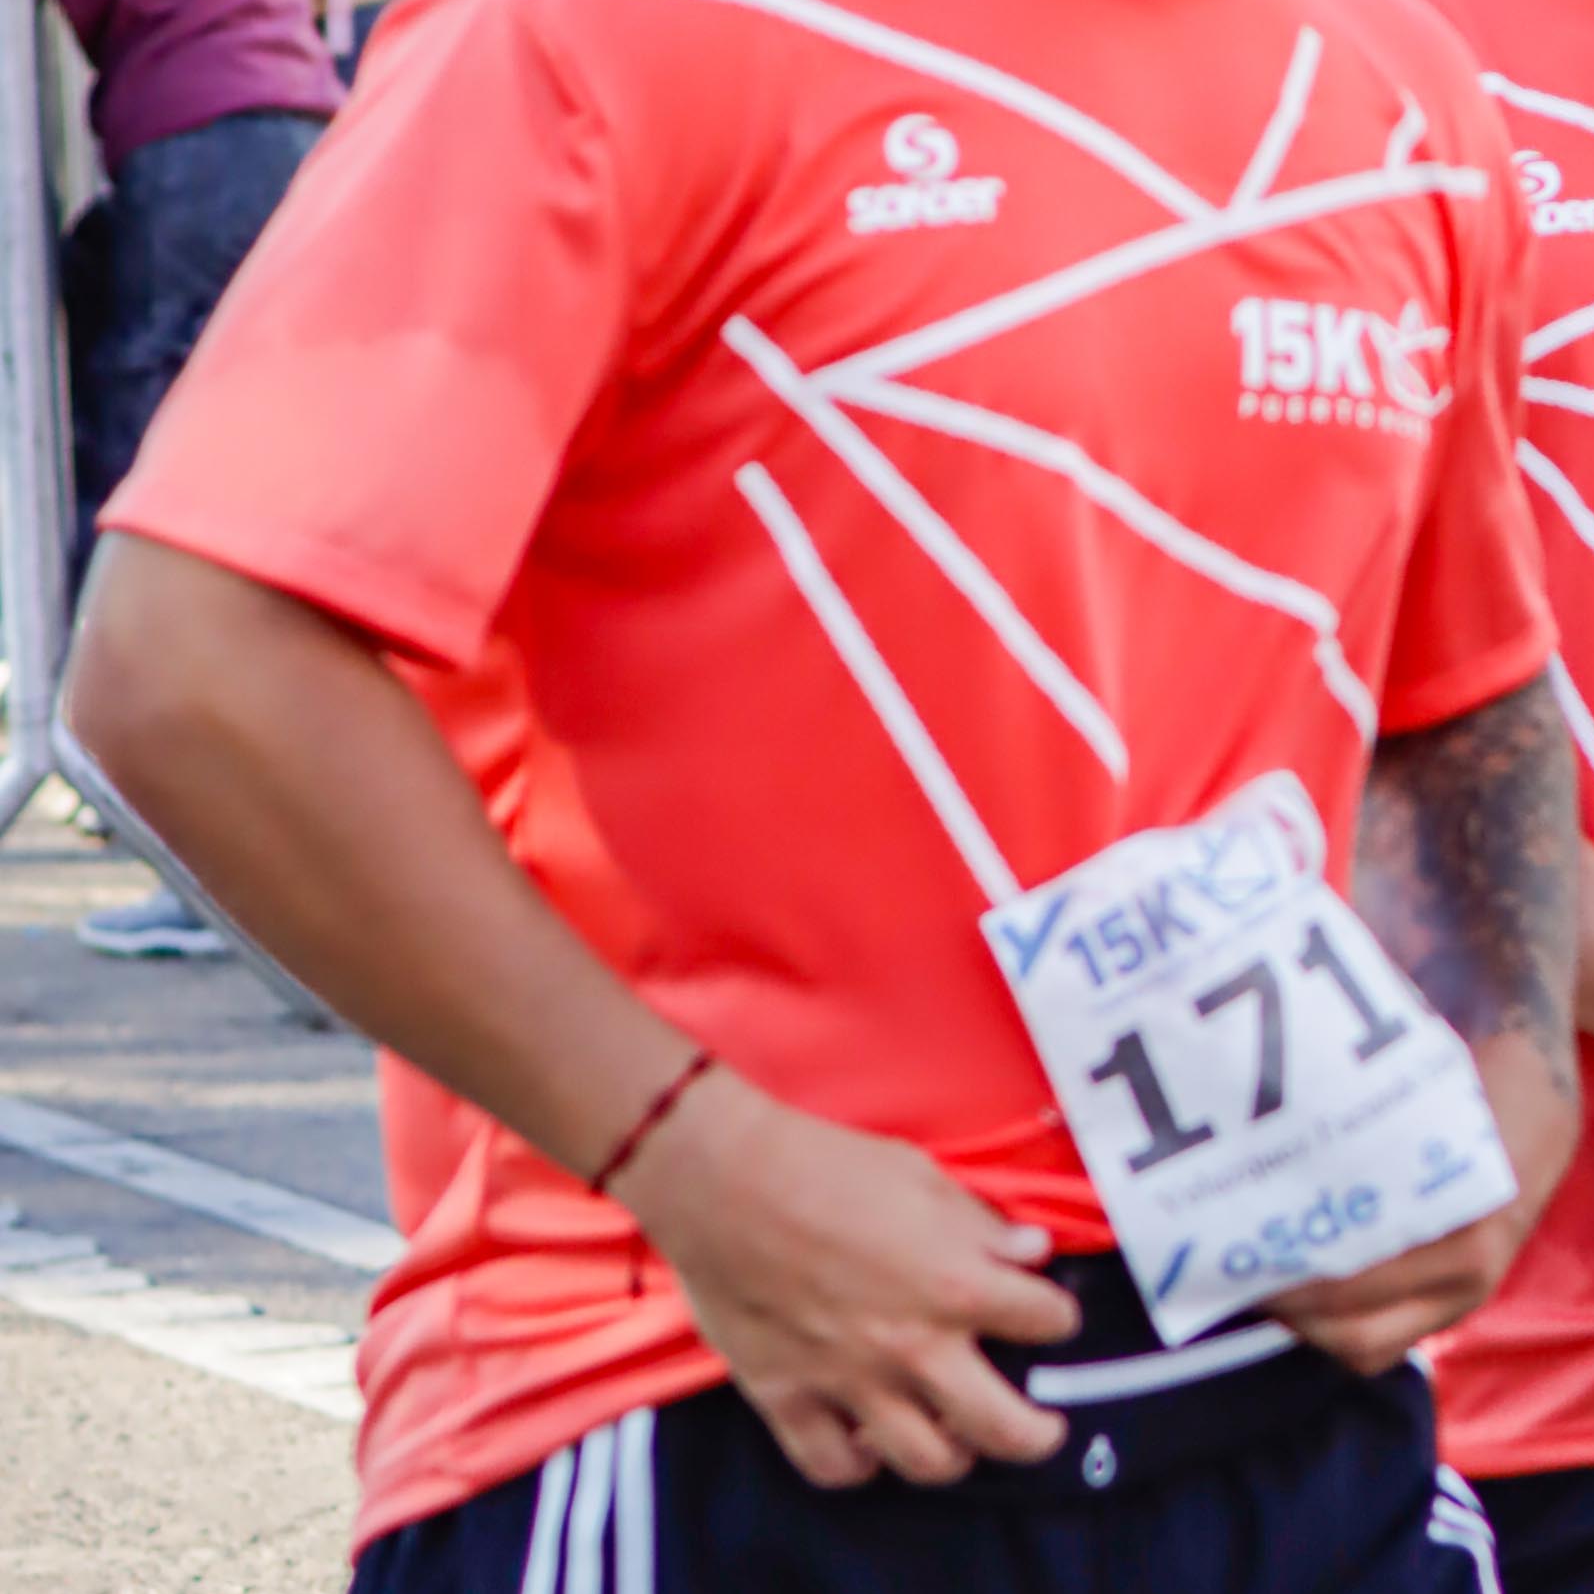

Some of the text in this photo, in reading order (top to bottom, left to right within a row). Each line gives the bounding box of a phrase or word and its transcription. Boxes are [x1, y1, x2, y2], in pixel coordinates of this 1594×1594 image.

[1230, 296, 1374, 397] 15K
[1066, 878, 1196, 987] 15K
[1088, 920, 1409, 1173] 171
[1221, 1182, 1381, 1281] osde
